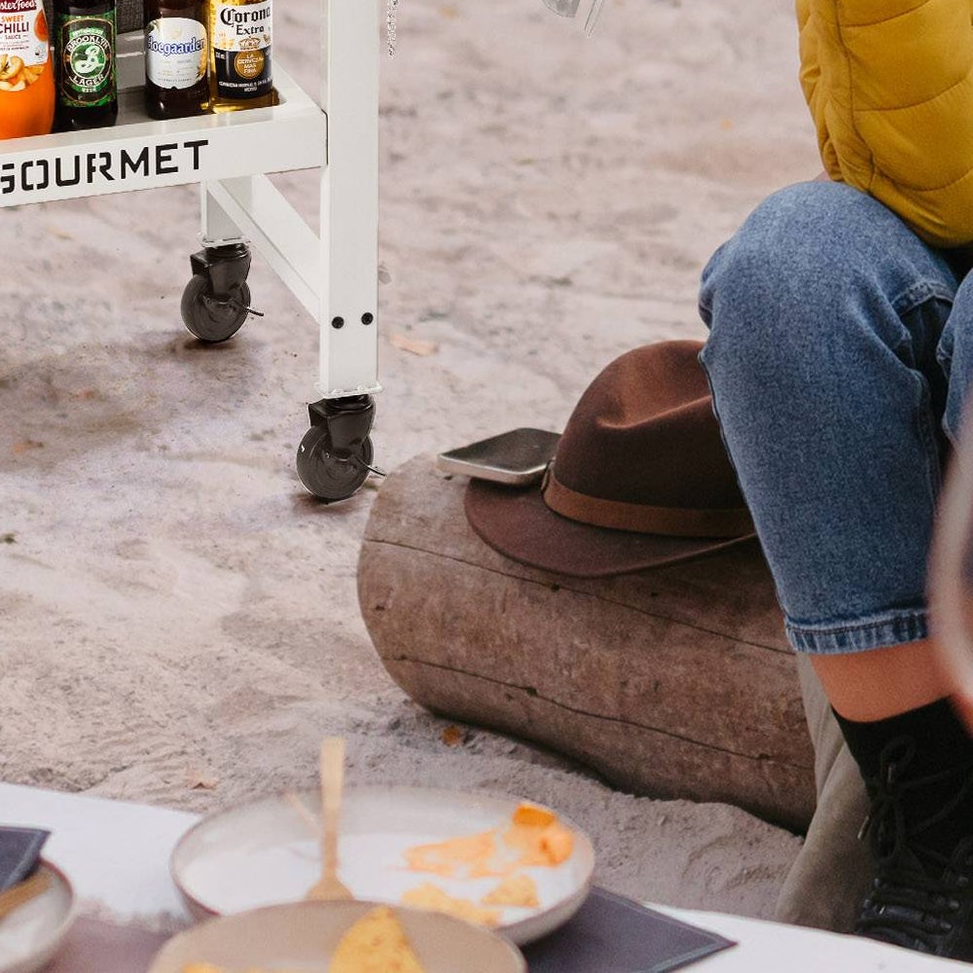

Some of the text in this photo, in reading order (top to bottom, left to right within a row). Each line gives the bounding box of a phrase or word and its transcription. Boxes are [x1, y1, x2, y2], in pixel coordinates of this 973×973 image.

[220, 6, 271, 27] Corona
[236, 25, 264, 36] Extra
[67, 35, 109, 52] BROOKLYN
[73, 74, 104, 86] LAGER
